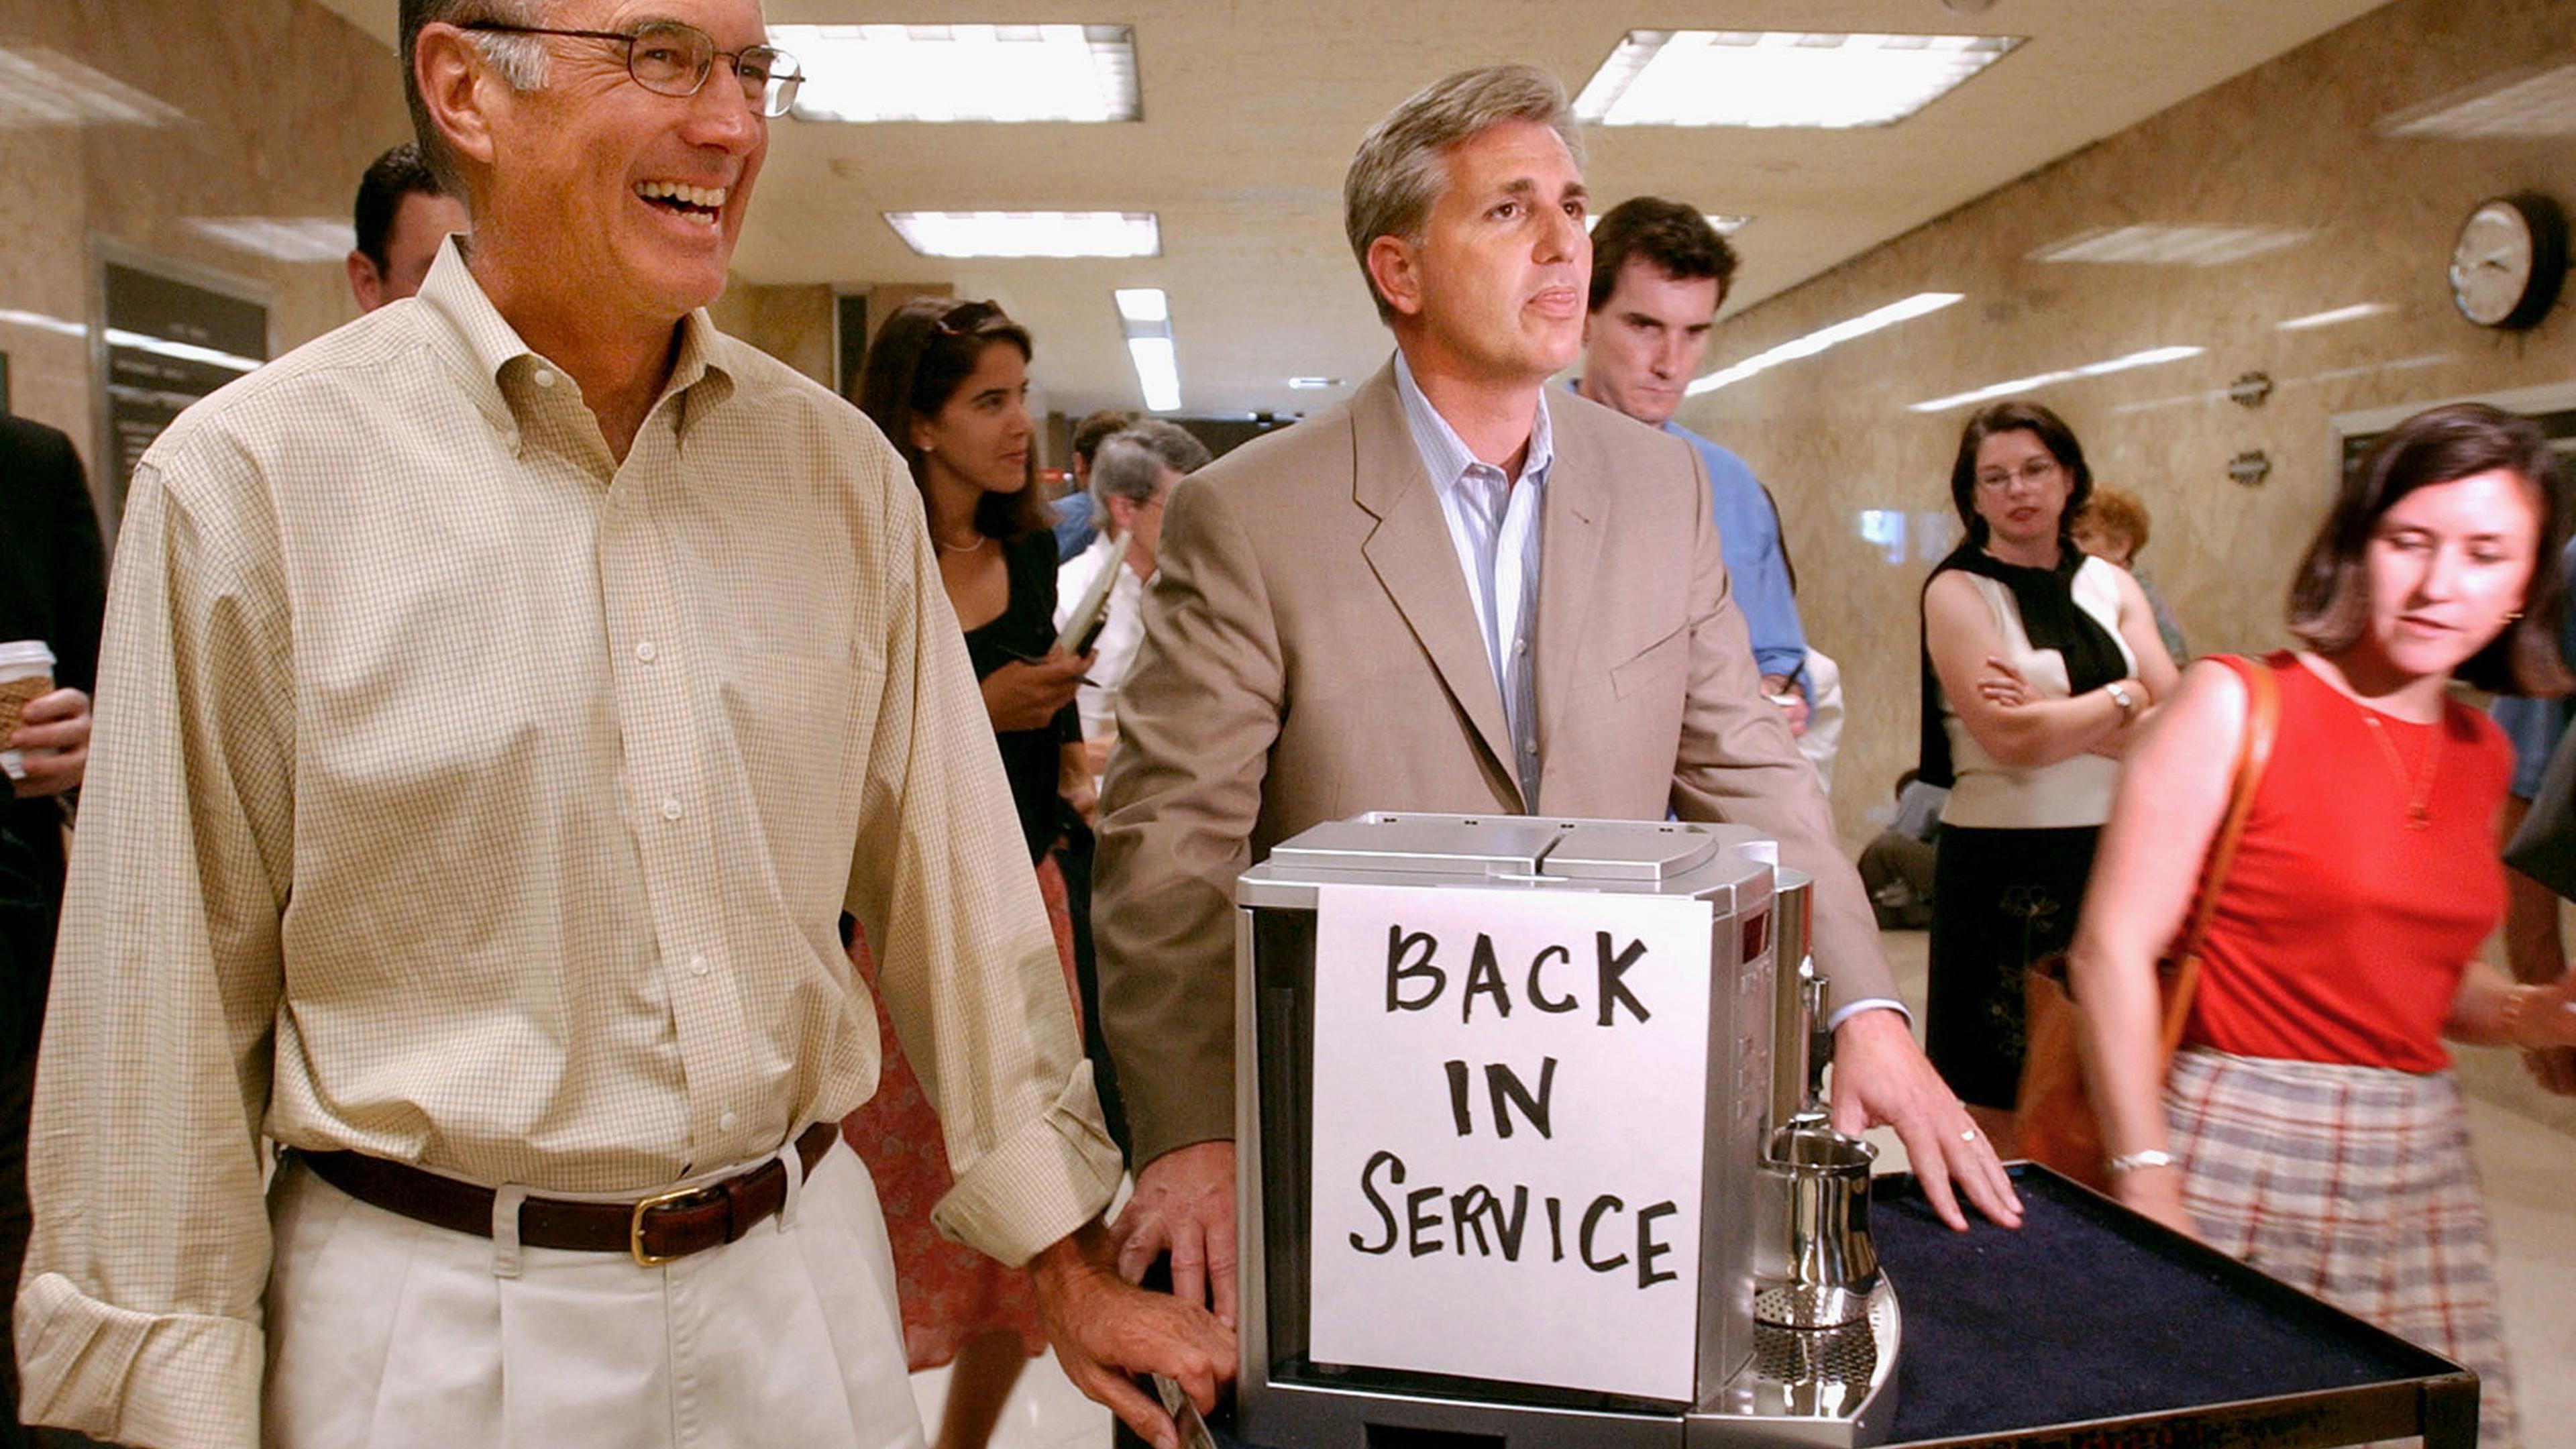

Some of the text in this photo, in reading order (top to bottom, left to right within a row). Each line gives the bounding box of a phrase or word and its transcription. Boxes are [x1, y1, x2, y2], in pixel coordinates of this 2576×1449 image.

[1387, 924, 1650, 1026] BACK
[1444, 1057, 1557, 1140] IN
[1349, 1150, 1678, 1289] SERVICE
